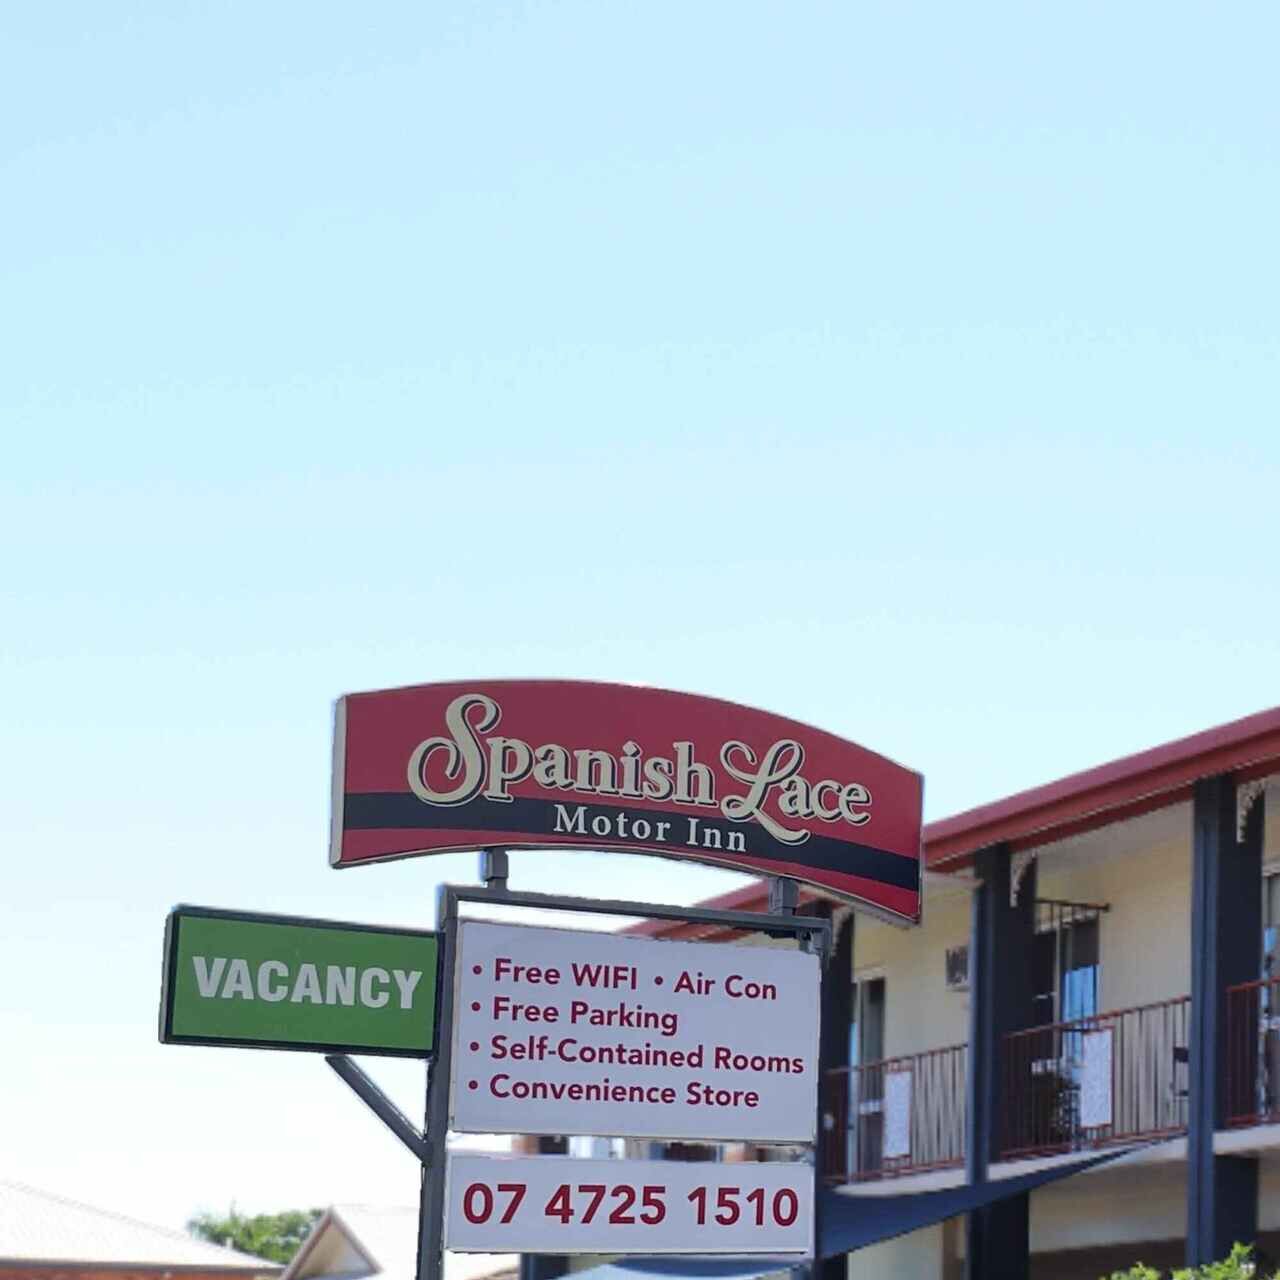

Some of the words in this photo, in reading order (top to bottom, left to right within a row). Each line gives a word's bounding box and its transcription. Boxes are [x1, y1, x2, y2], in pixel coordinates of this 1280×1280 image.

[408, 694, 718, 807] Spanish
[720, 738, 872, 845] Lace
[554, 804, 672, 841] Motor
[687, 820, 747, 852] Inn
[192, 956, 423, 1009] VACANCY
[494, 958, 561, 985] Free
[572, 963, 638, 990] WIFI
[674, 971, 716, 995] Air
[725, 975, 777, 1000] Con
[493, 996, 559, 1023] Free
[570, 1001, 678, 1036] Parking
[490, 1034, 703, 1068] Self-Contained
[714, 1046, 804, 1074] Rooms
[490, 1074, 676, 1104] Convenience
[686, 1082, 760, 1107] Store
[463, 1183, 527, 1224] 07
[545, 1184, 666, 1225] 4725
[687, 1186, 798, 1227] 1510
